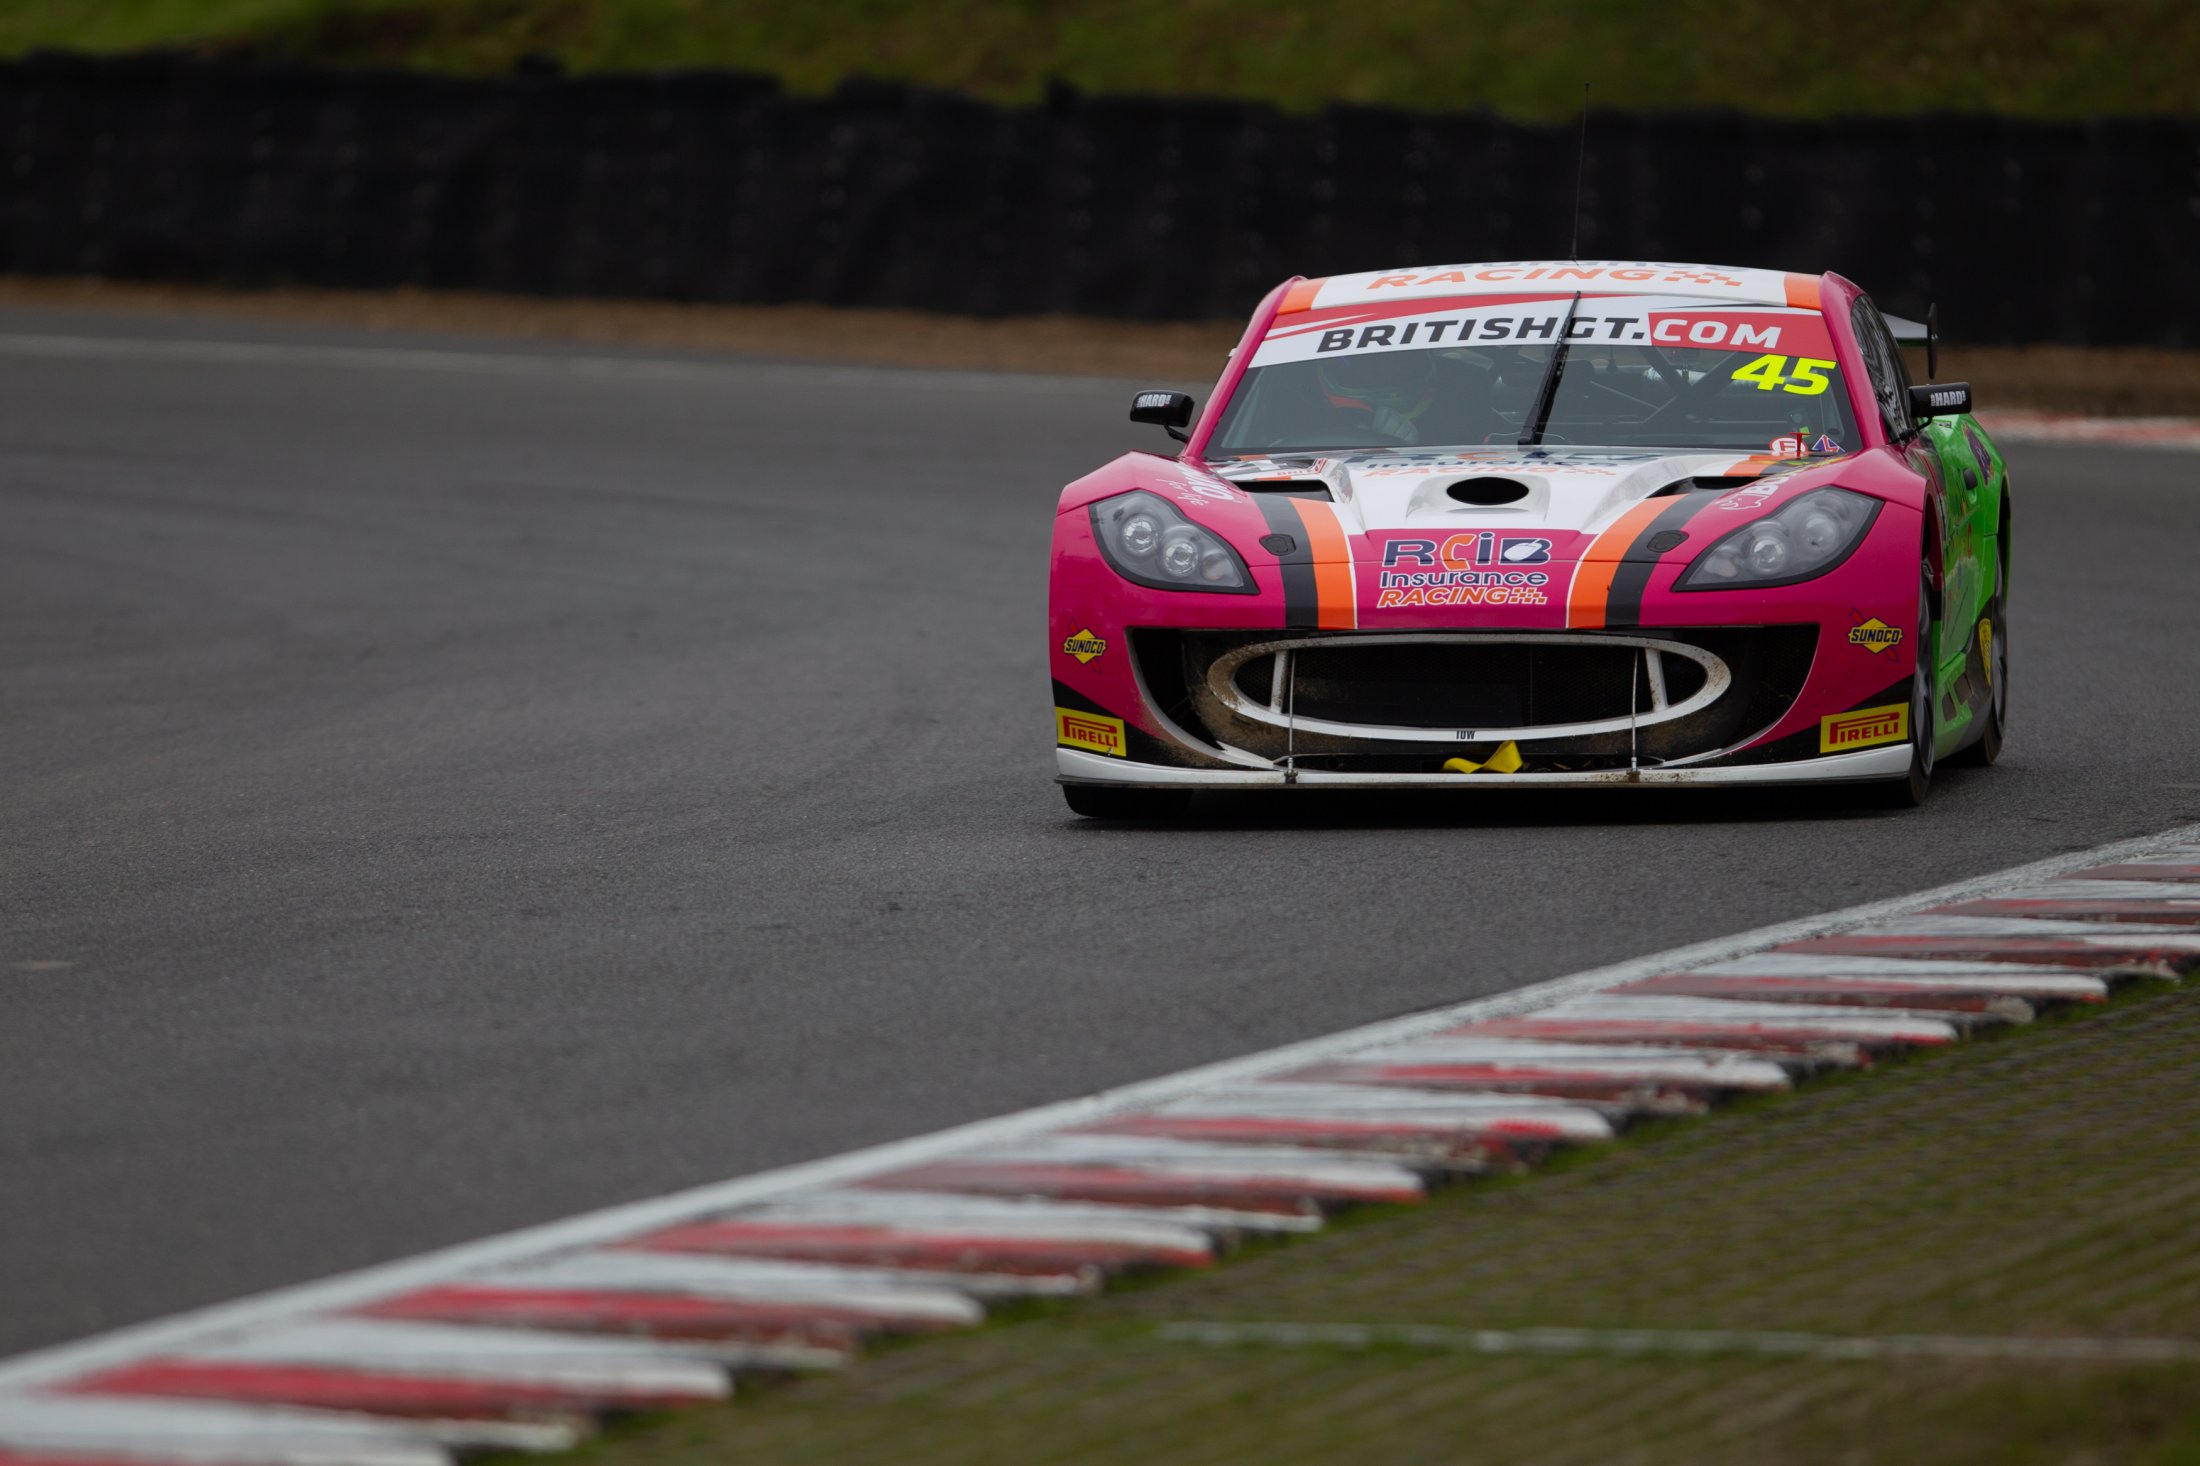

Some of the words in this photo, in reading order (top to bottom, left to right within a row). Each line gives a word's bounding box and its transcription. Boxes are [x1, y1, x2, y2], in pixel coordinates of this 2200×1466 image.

[1366, 268, 1661, 290] RACING
[1317, 317, 1782, 352] BRITISHGT.COM
[1731, 354, 1837, 396] 45
[1380, 571, 1548, 588] Insurance
[1377, 587, 1511, 608] RACING
[1065, 639, 1105, 654] SUNOCO
[1851, 629, 1900, 643] SUNOCO
[1062, 715, 1119, 748] PIRELLI
[1829, 712, 1900, 744] PIRELLI
